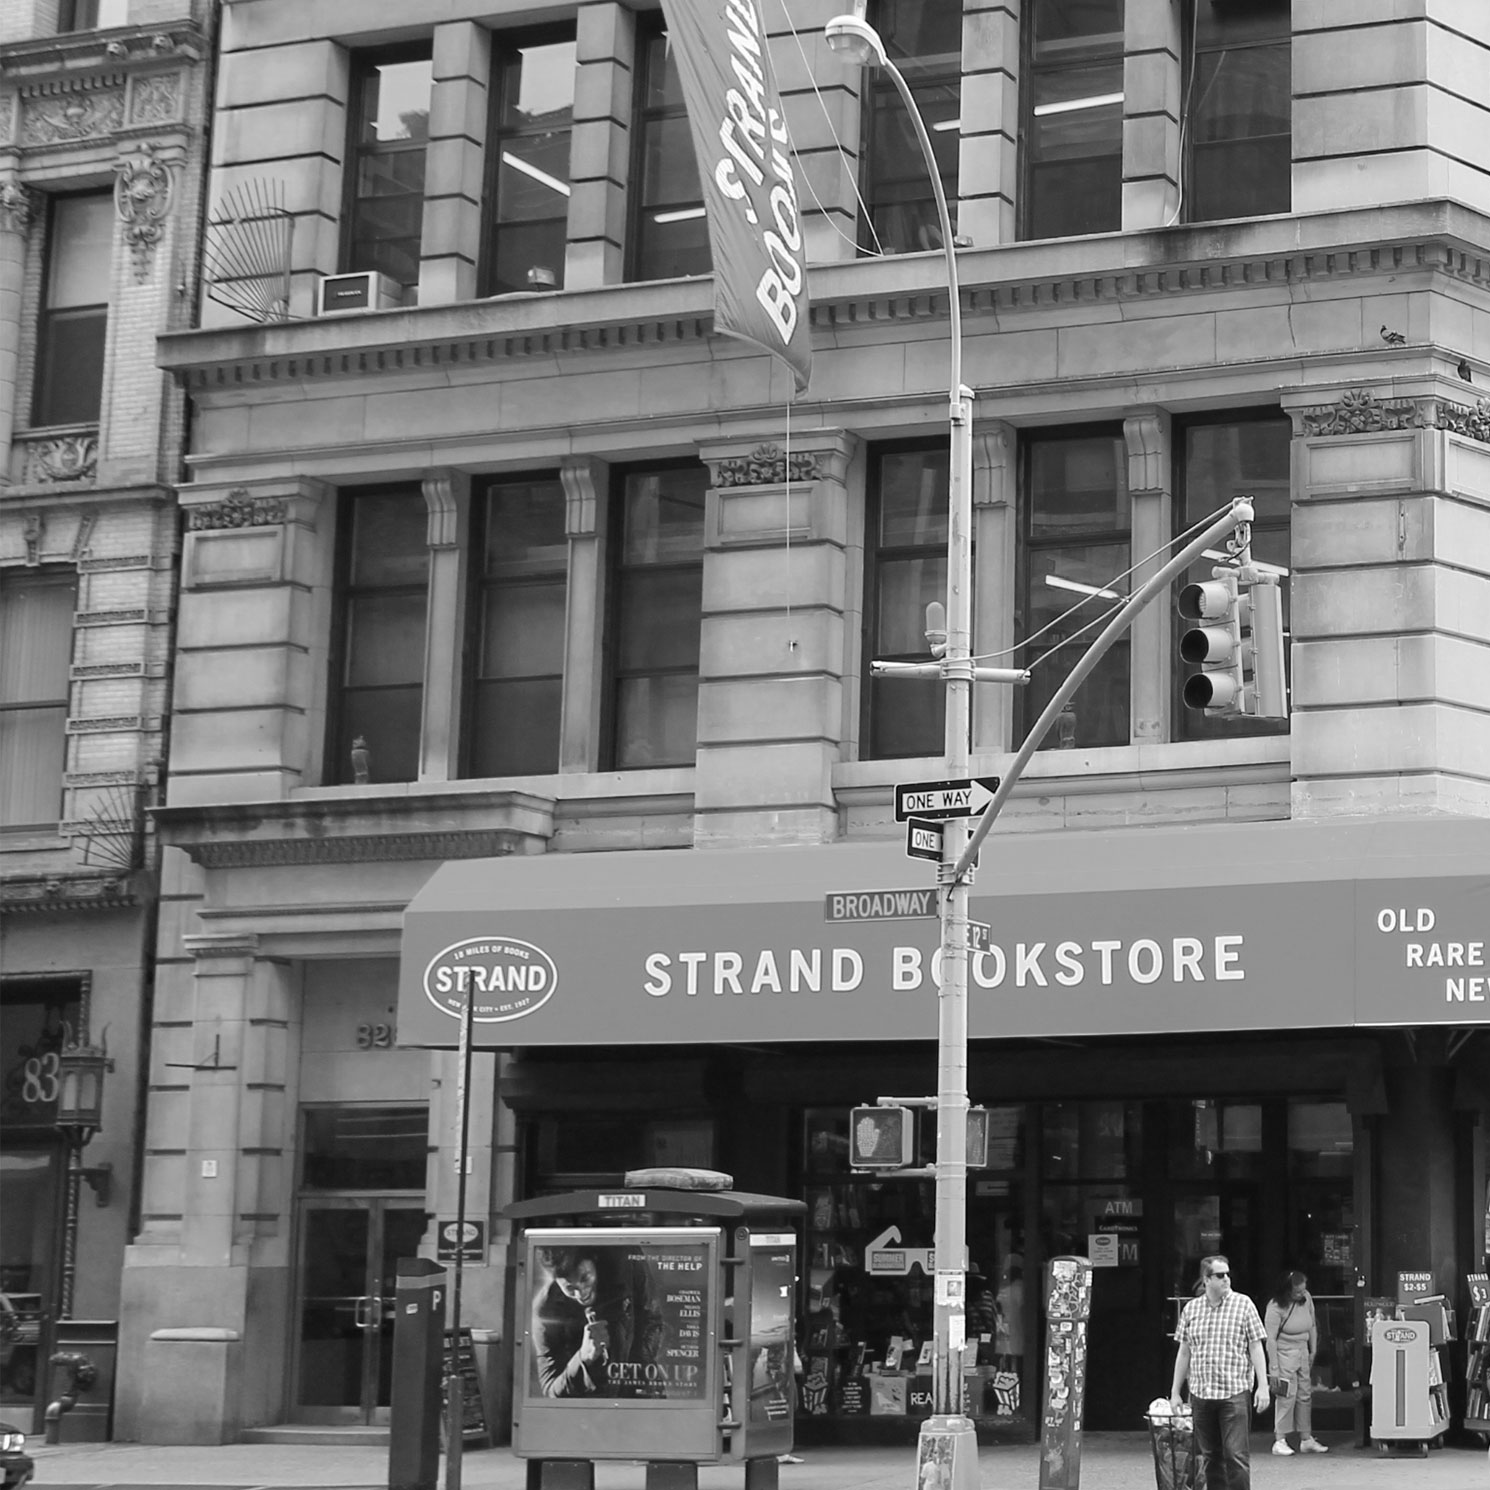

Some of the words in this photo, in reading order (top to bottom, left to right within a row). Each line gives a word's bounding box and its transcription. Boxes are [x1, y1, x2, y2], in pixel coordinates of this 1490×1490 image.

[906, 794, 934, 810] ONE
[942, 790, 972, 807] WAY
[914, 830, 936, 849] ONE
[832, 891, 932, 918] BROADWAY
[1377, 908, 1435, 932] OLD
[971, 926, 982, 949] 12
[465, 945, 490, 956] MILES
[491, 945, 502, 954] OF
[503, 946, 530, 960] BOOKS
[1406, 942, 1484, 967] RARE
[435, 965, 548, 993] STRAND
[643, 947, 864, 997] STRAND
[604, 1196, 640, 1207] TITAN
[1104, 1201, 1133, 1214] ATM
[657, 1261, 675, 1271] THE
[677, 1262, 703, 1271] HELP
[1399, 1273, 1432, 1281] STRAND
[1403, 1282, 1427, 1292] $2-$5
[432, 1290, 442, 1311] P
[606, 1362, 642, 1379] GET
[645, 1363, 669, 1380] ON
[674, 1364, 698, 1381] UP
